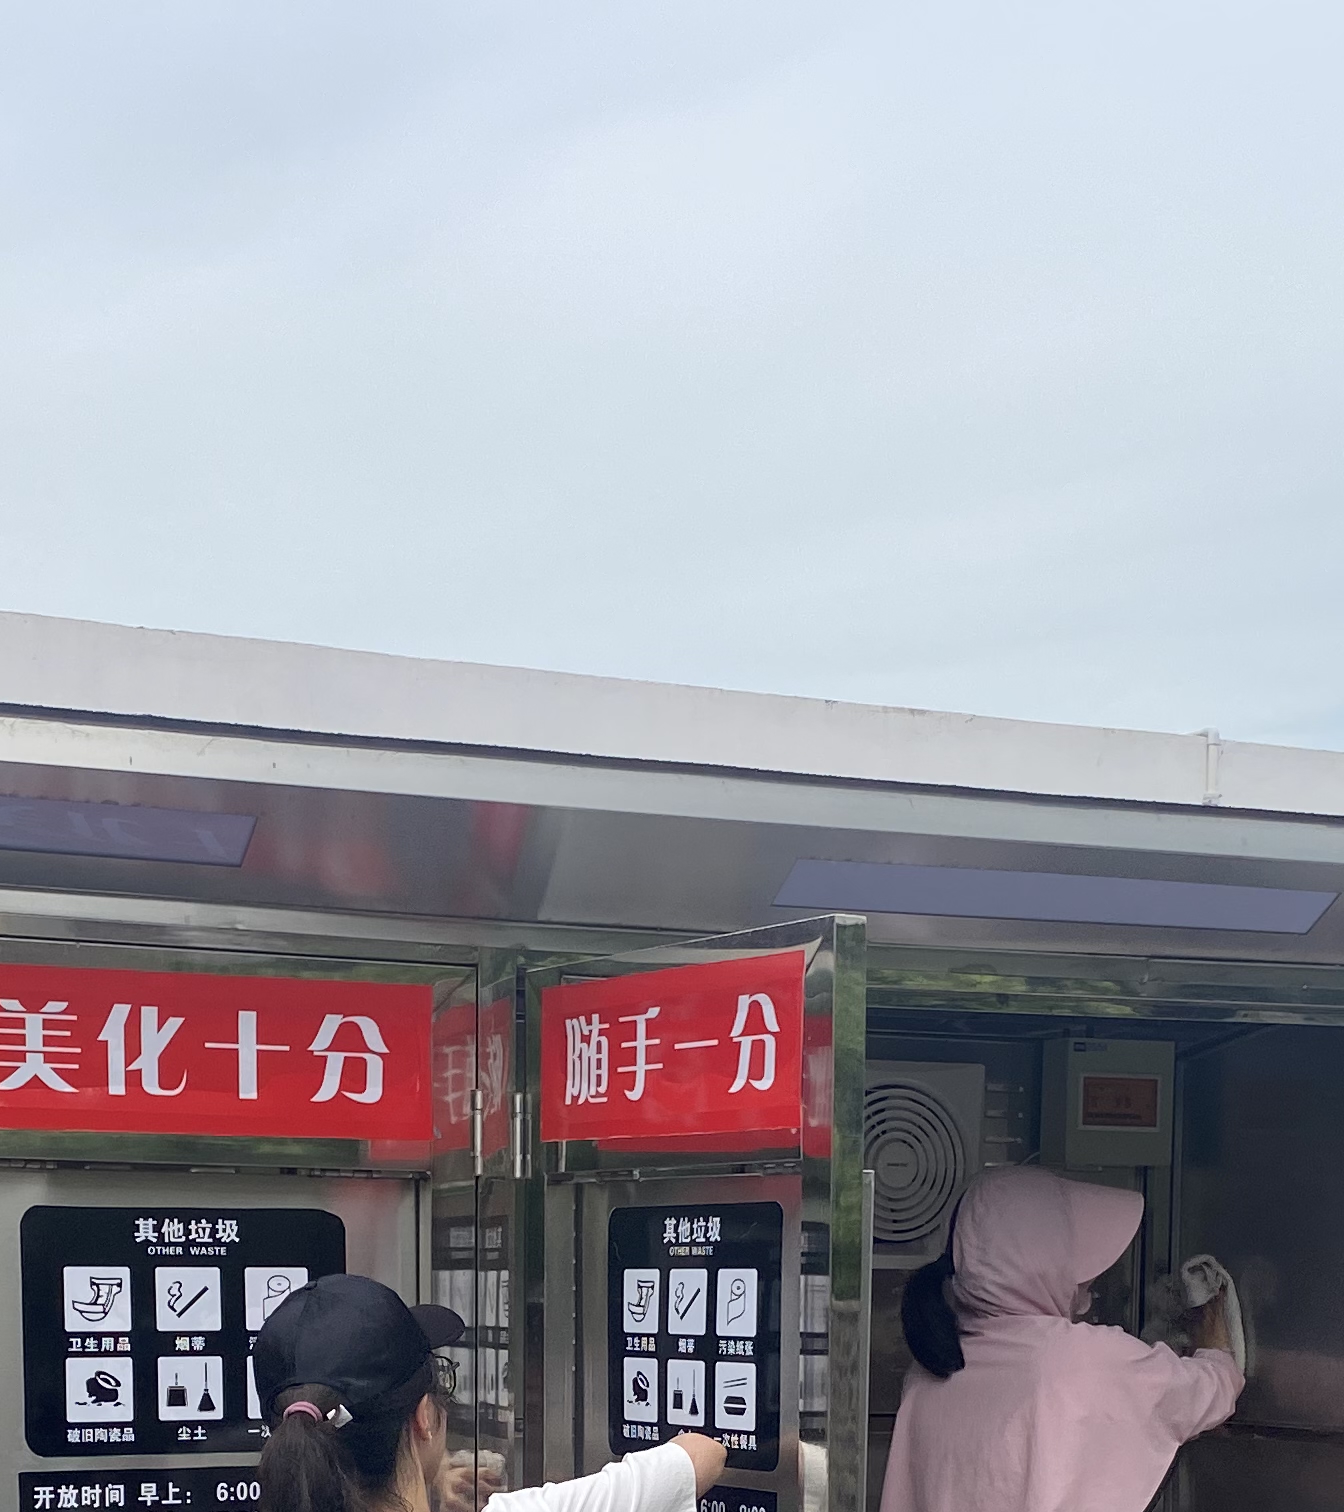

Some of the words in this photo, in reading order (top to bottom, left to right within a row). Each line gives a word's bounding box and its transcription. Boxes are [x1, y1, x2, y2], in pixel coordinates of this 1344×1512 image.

[564, 993, 781, 1105] 随手一分
[134, 1217, 240, 1243] 其他垃圾
[663, 1216, 721, 1243] 其他垃圾
[147, 1246, 183, 1256] OTHER
[190, 1246, 227, 1256] WASTE
[669, 1246, 690, 1257] OTHER
[692, 1246, 713, 1257] WASTE
[67, 1336, 131, 1352] 卫生用品
[175, 1336, 205, 1351] 烟蒂
[626, 1336, 656, 1352] 卫生用品
[67, 1427, 135, 1443] 破旧陶瓷品
[177, 1426, 208, 1441] 尘土
[33, 1484, 125, 1509] 开放时间
[216, 1482, 261, 1501] 6:00
